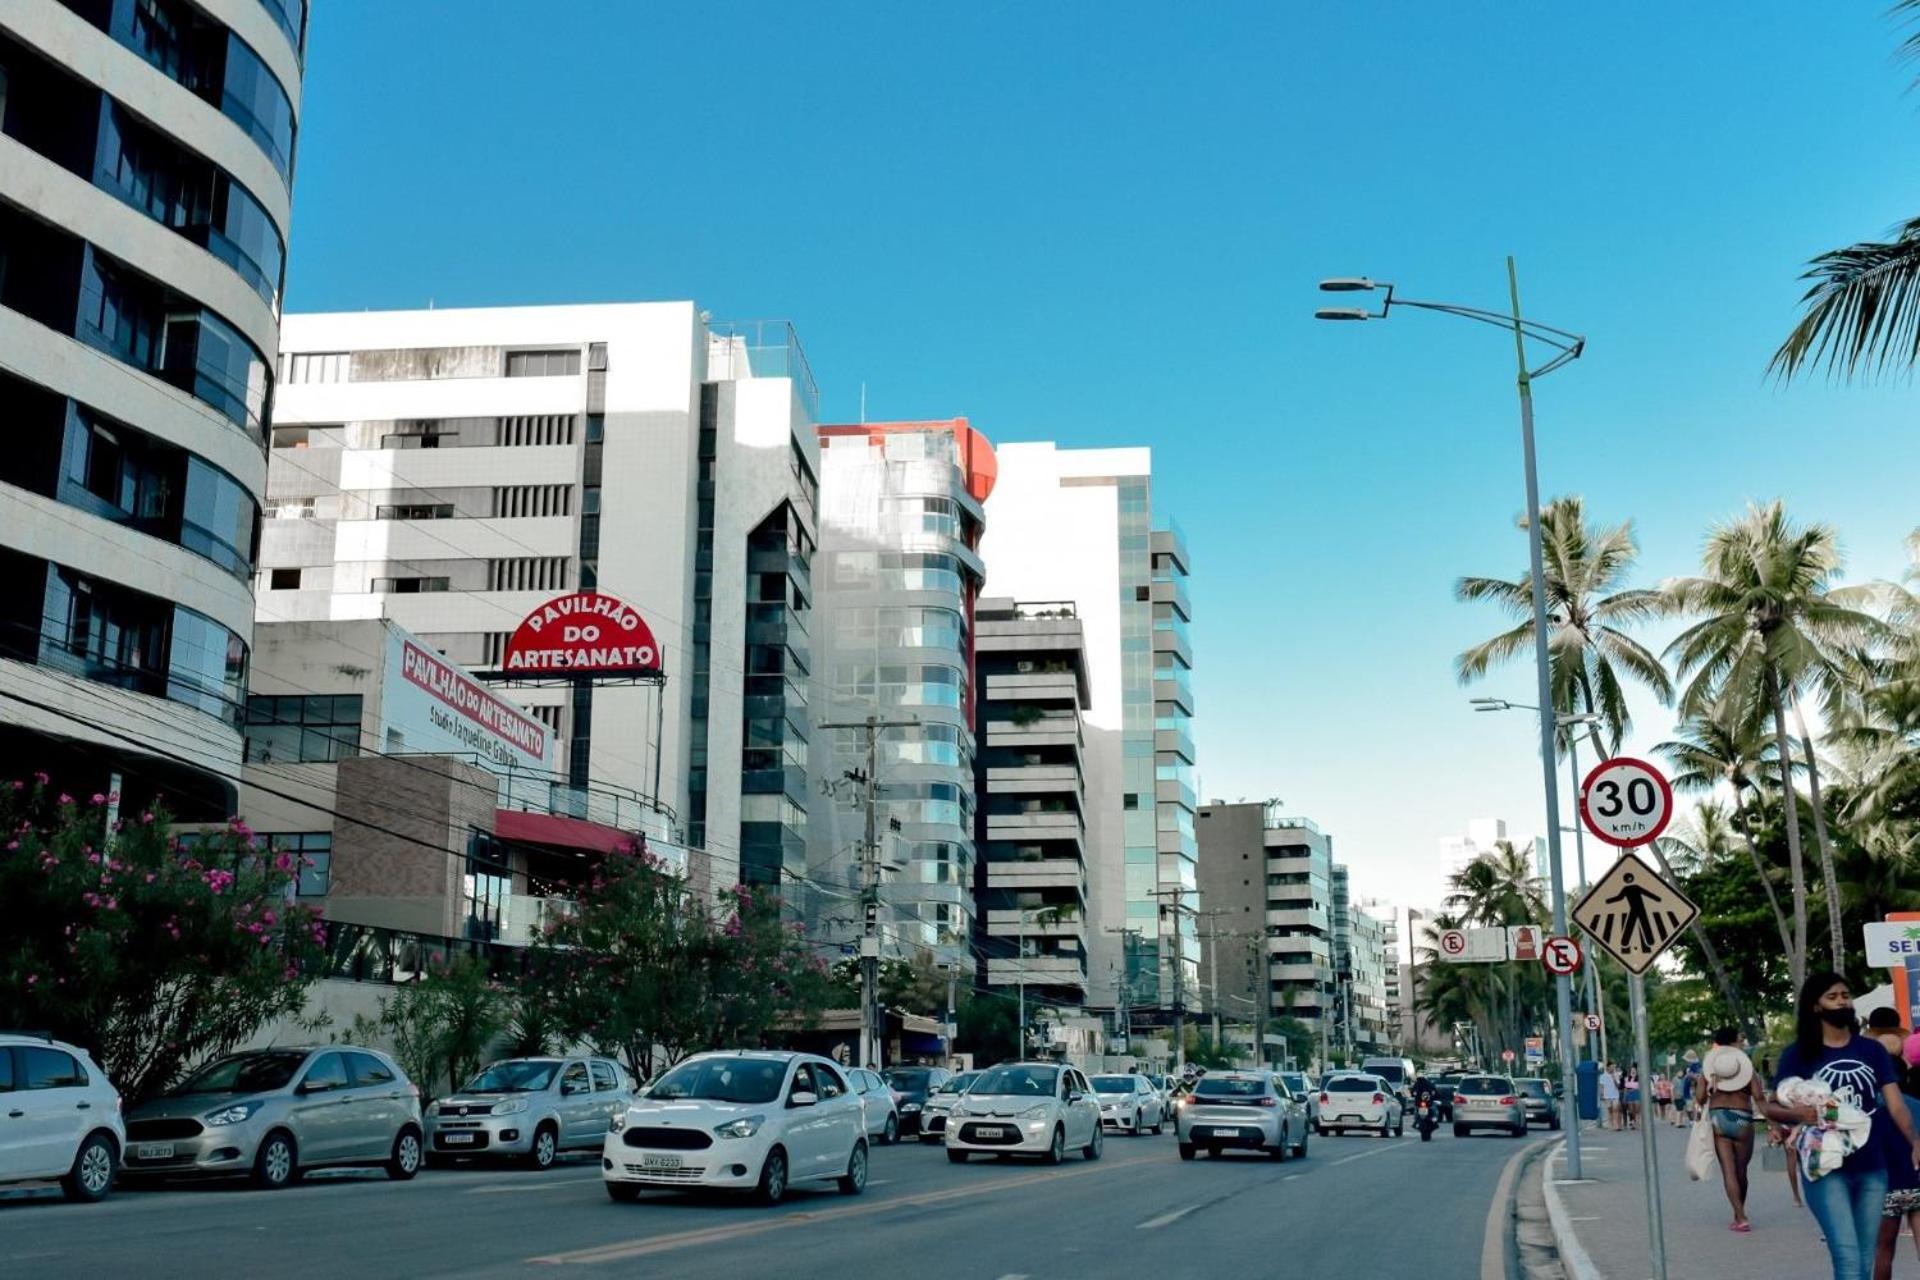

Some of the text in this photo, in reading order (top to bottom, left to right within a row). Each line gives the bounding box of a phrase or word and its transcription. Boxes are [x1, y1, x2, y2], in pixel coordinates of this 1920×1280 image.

[528, 596, 638, 632] PAVILHÃO
[563, 625, 600, 643] DO
[508, 646, 654, 669] ARTESANATO
[405, 648, 542, 754] PAVILHÃO DO ARTESANATO
[1596, 777, 1656, 818] 30
[1612, 821, 1646, 833] km/h
[1889, 940, 1912, 953] SE
